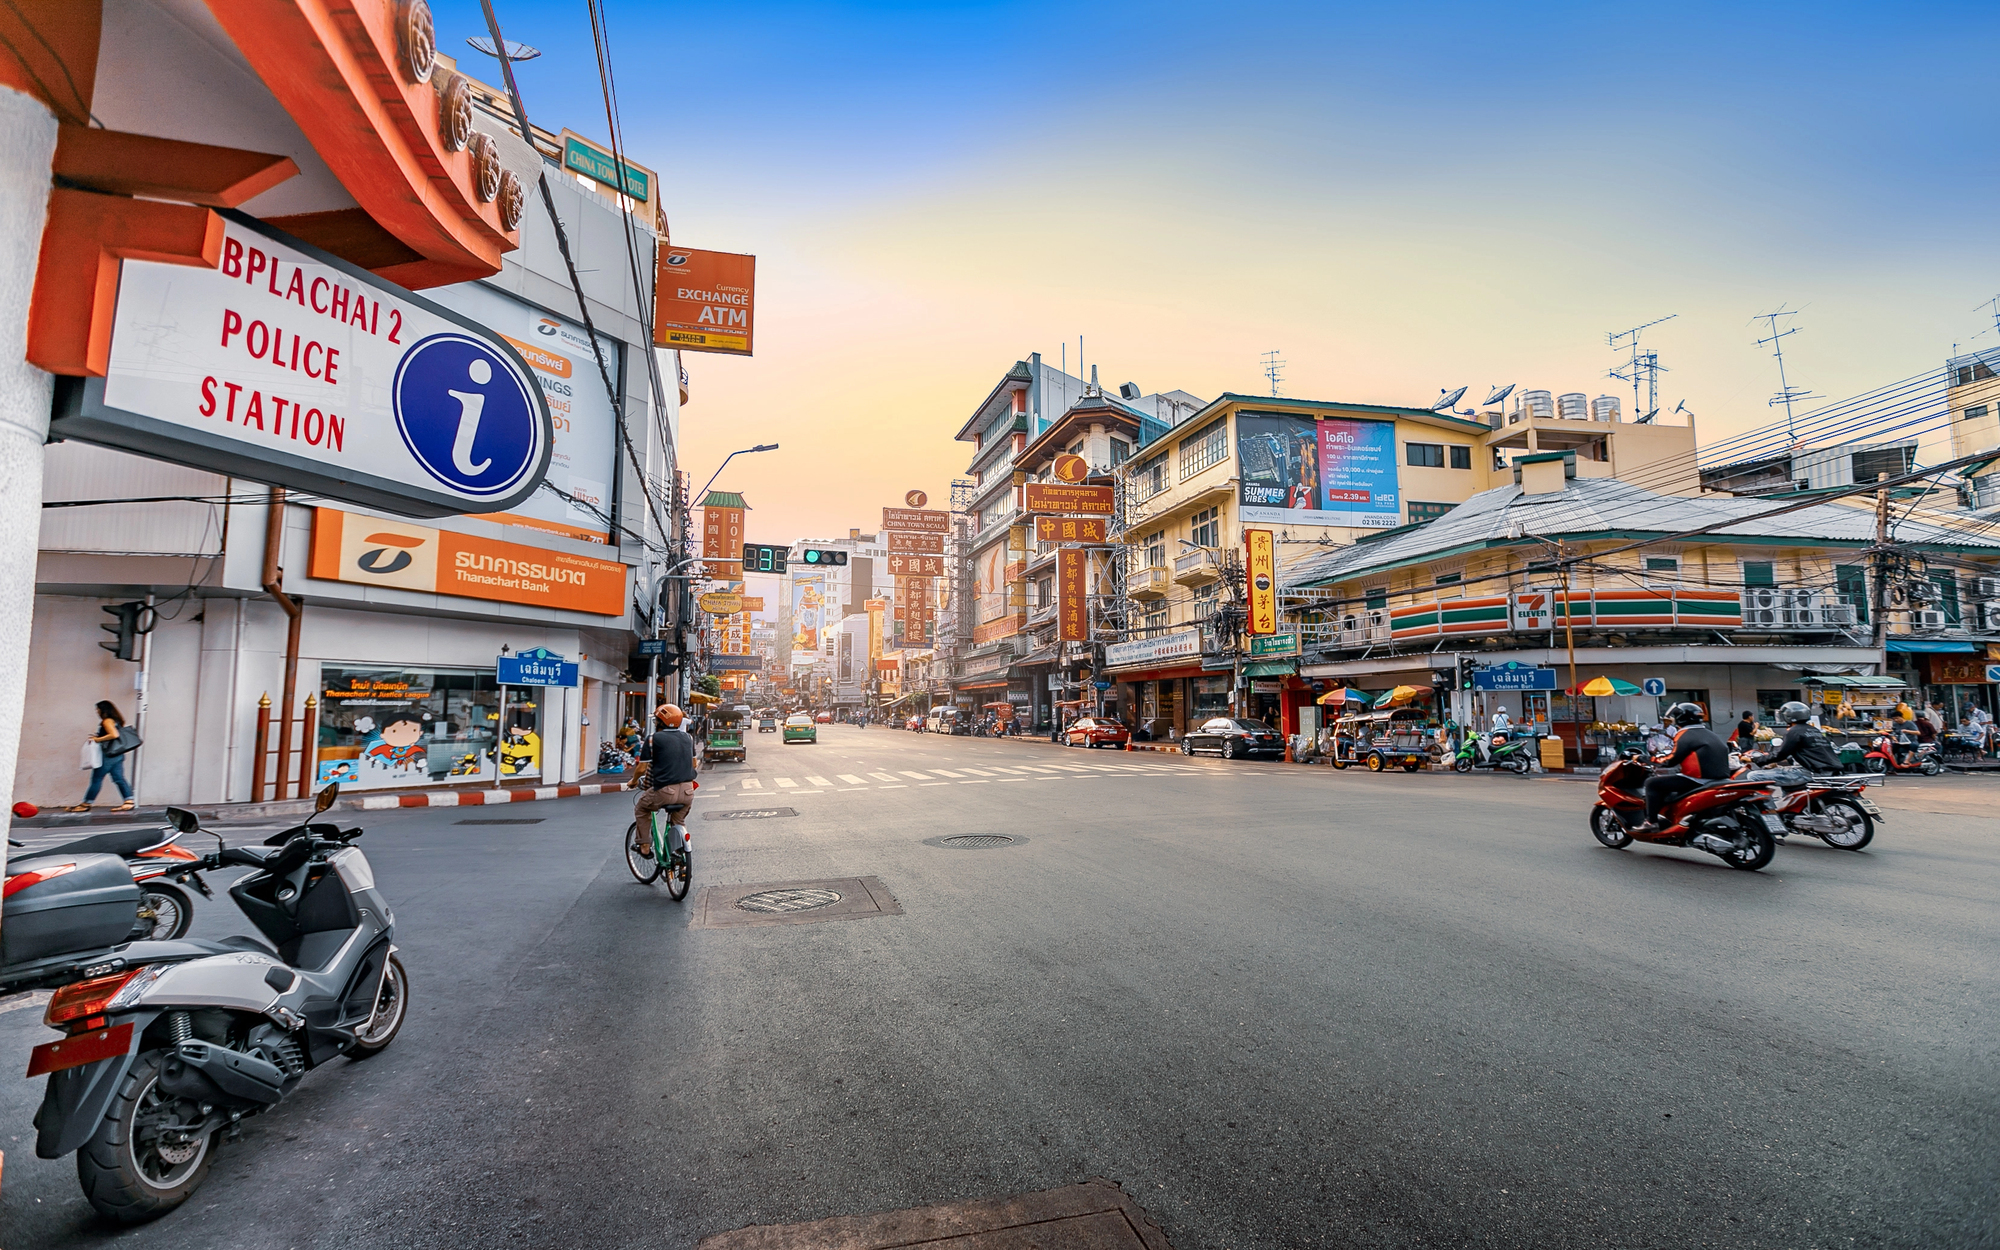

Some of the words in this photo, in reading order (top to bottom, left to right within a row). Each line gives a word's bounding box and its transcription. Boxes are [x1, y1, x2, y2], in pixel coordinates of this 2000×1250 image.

[570, 150, 596, 173] CHINA
[597, 162, 618, 183] TOW
[222, 236, 379, 335] BPLACHAI
[388, 309, 402, 345] 2
[677, 288, 749, 305] EXCHANGE
[716, 283, 750, 294] Currency
[697, 306, 747, 327] ATM
[221, 308, 339, 385] POLICE
[199, 376, 345, 453] STATION
[1324, 430, 1354, 443] ไอดีโอ
[1244, 486, 1285, 497] SUMMER
[1245, 495, 1267, 503] VIBES
[1082, 499, 1111, 511] สกาล่า
[1041, 519, 1099, 541] 中國城
[760, 548, 772, 571] 3
[1254, 535, 1269, 570] 貴州
[455, 551, 586, 586] ธนาคารธนชาต
[891, 556, 938, 574] 中國城
[455, 569, 520, 589] Thanachart
[521, 582, 550, 593] Bank
[1065, 553, 1079, 637] 銀都魚翅酒樓
[1518, 594, 1545, 628] 7
[520, 662, 561, 679] เฉลิมบุรี
[522, 676, 546, 684] Chaloem
[1492, 671, 1535, 684] เฉลิมบุรี
[325, 690, 370, 698] Thanachart
